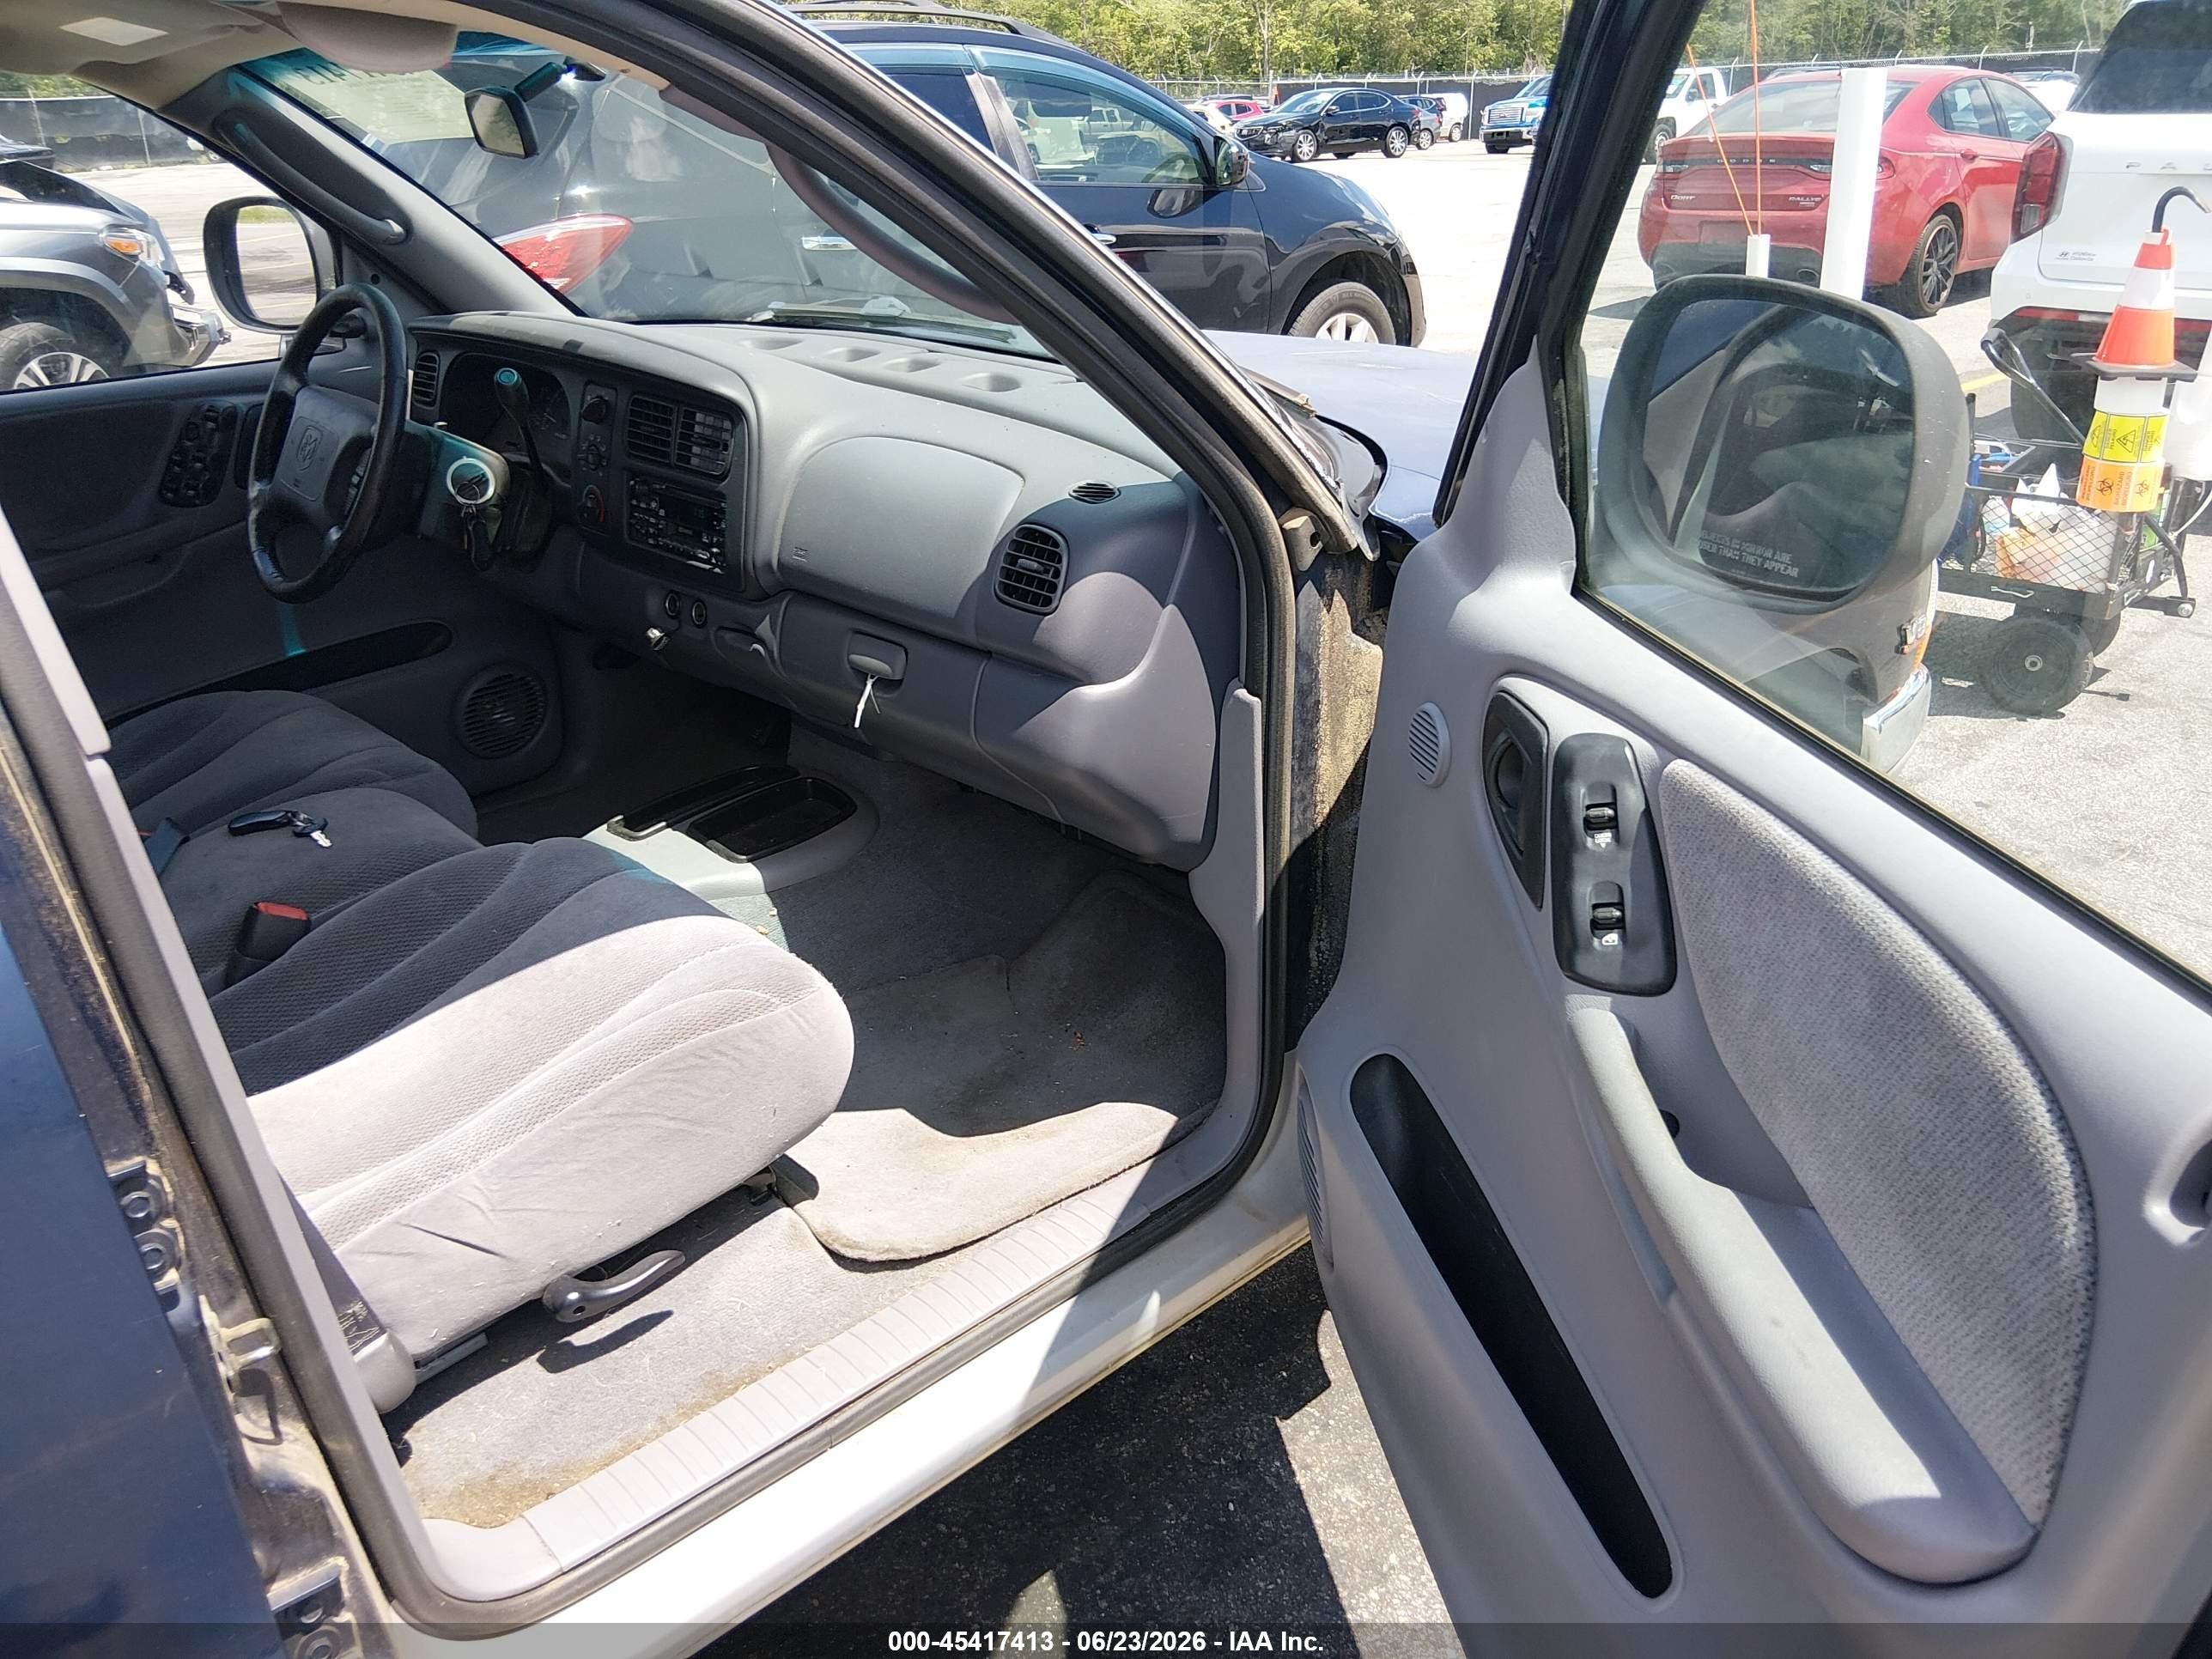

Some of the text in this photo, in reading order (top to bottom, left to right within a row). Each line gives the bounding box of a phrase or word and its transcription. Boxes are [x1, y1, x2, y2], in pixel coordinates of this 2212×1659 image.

[1703, 529, 1731, 546] BJECTS
[1773, 550, 1794, 564] ARE
[1740, 552, 1764, 568] THEY
[1763, 559, 1800, 578] APPEAR
